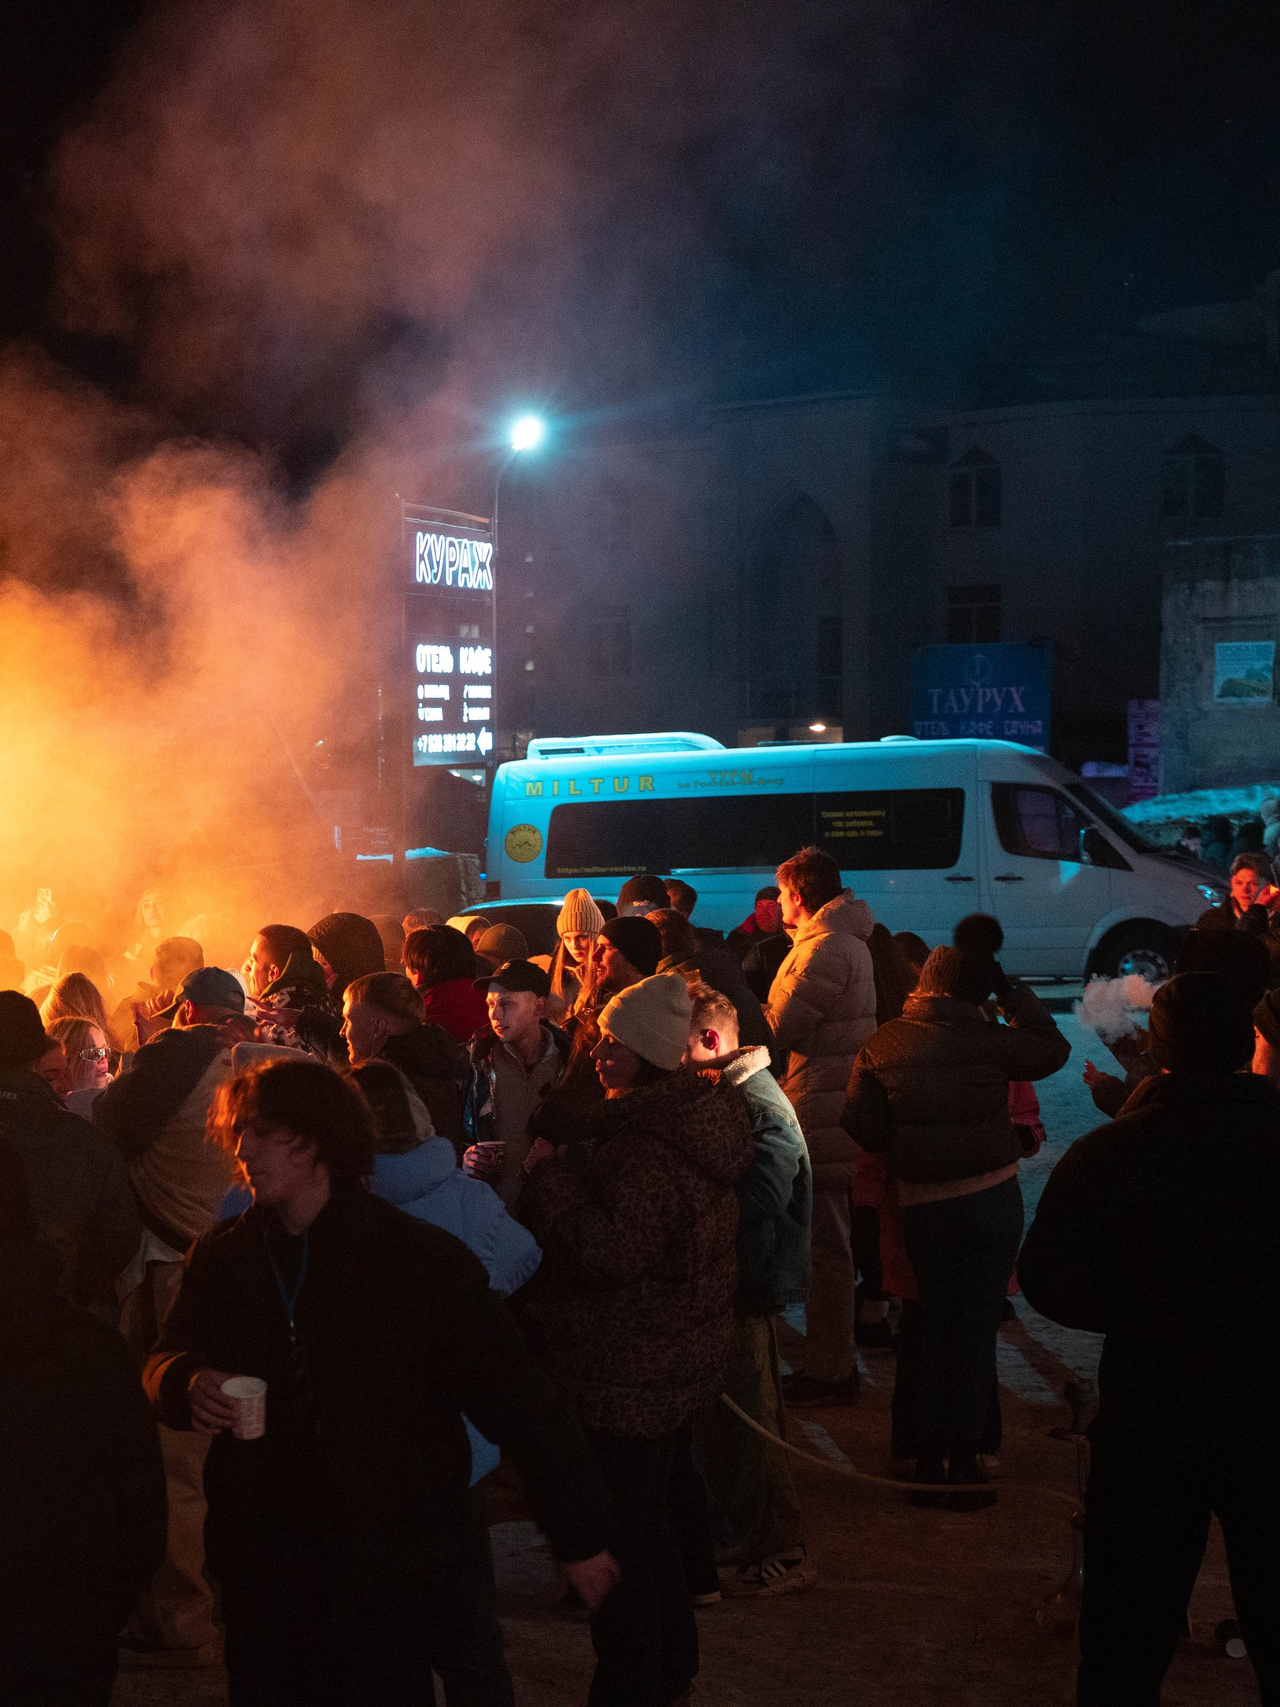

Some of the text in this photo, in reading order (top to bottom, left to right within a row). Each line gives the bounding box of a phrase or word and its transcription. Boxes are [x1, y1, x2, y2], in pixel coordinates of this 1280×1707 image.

[415, 532, 494, 590] КУРАЖ
[416, 643, 492, 676] ОТЕЛЬ КАФЕ
[928, 686, 1026, 714] ТАУРУХ
[525, 775, 655, 797] MILTUR
